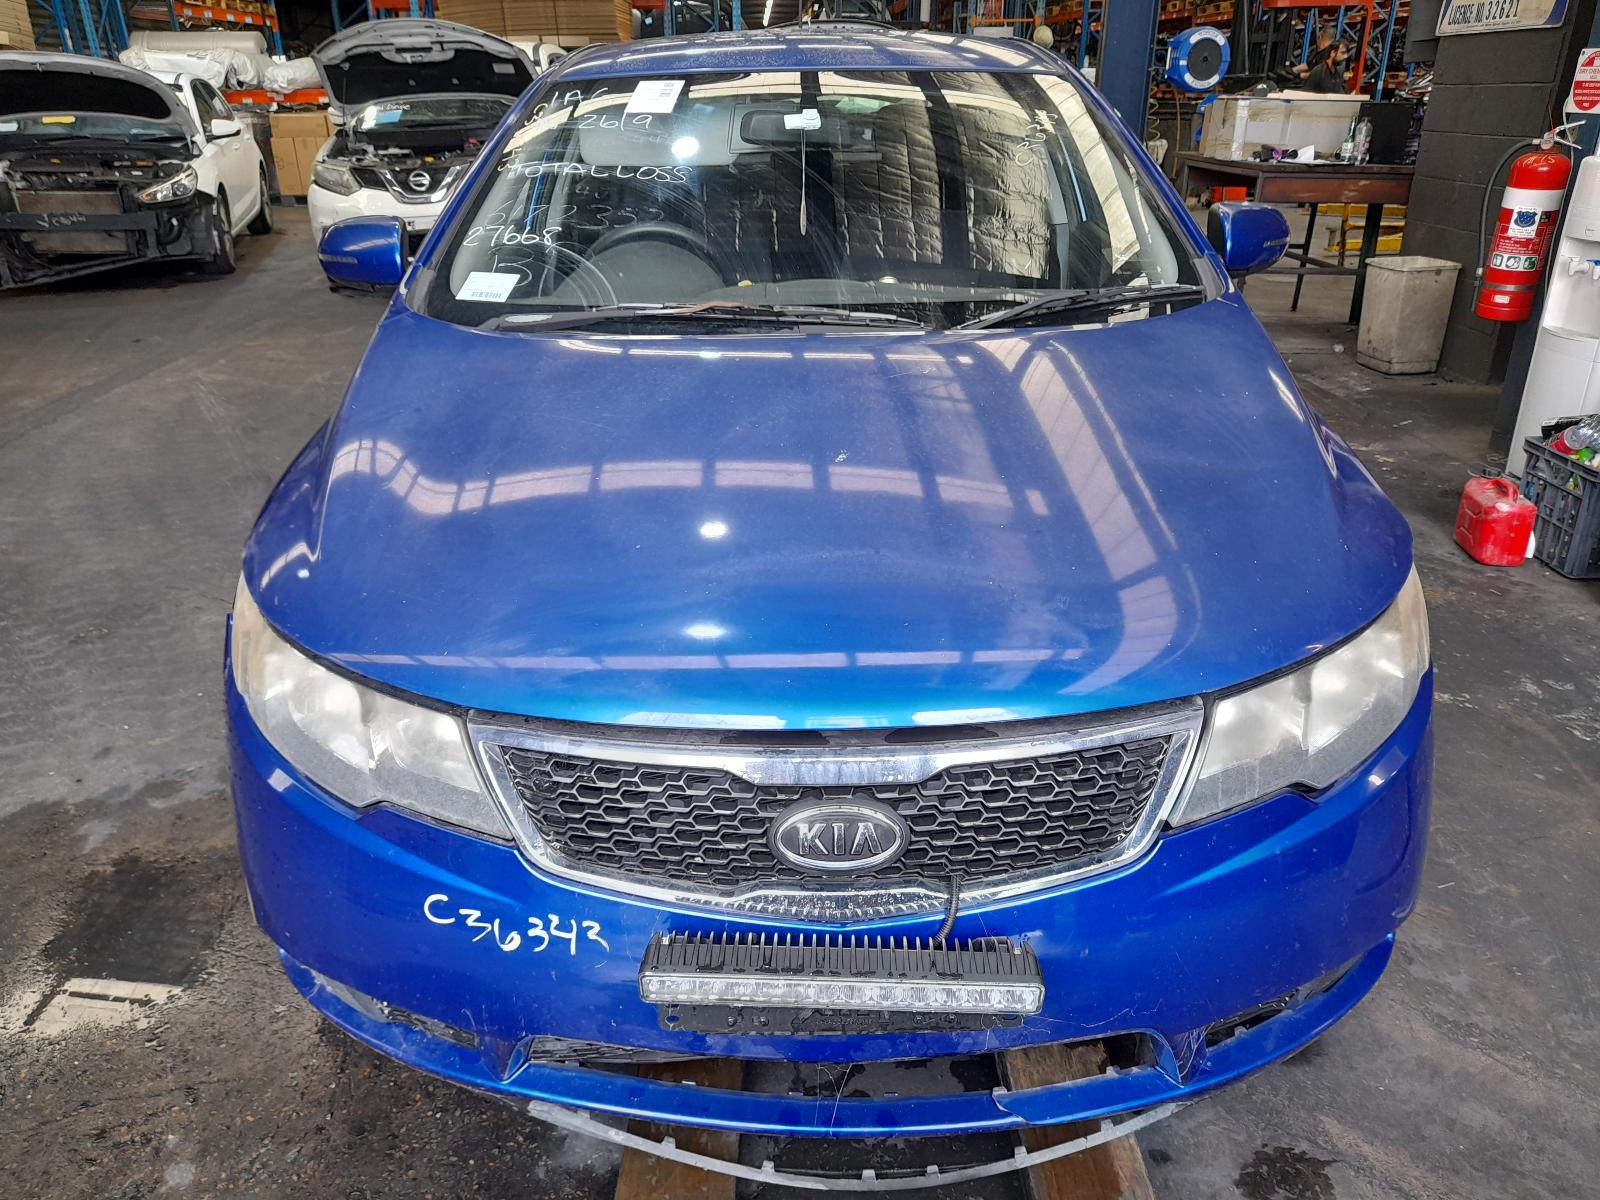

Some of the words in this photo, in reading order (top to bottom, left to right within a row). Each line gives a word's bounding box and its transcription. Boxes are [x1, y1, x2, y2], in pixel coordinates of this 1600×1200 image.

[616, 164, 693, 183] LOSS
[463, 224, 562, 247] 27668
[797, 822, 882, 855] KIA
